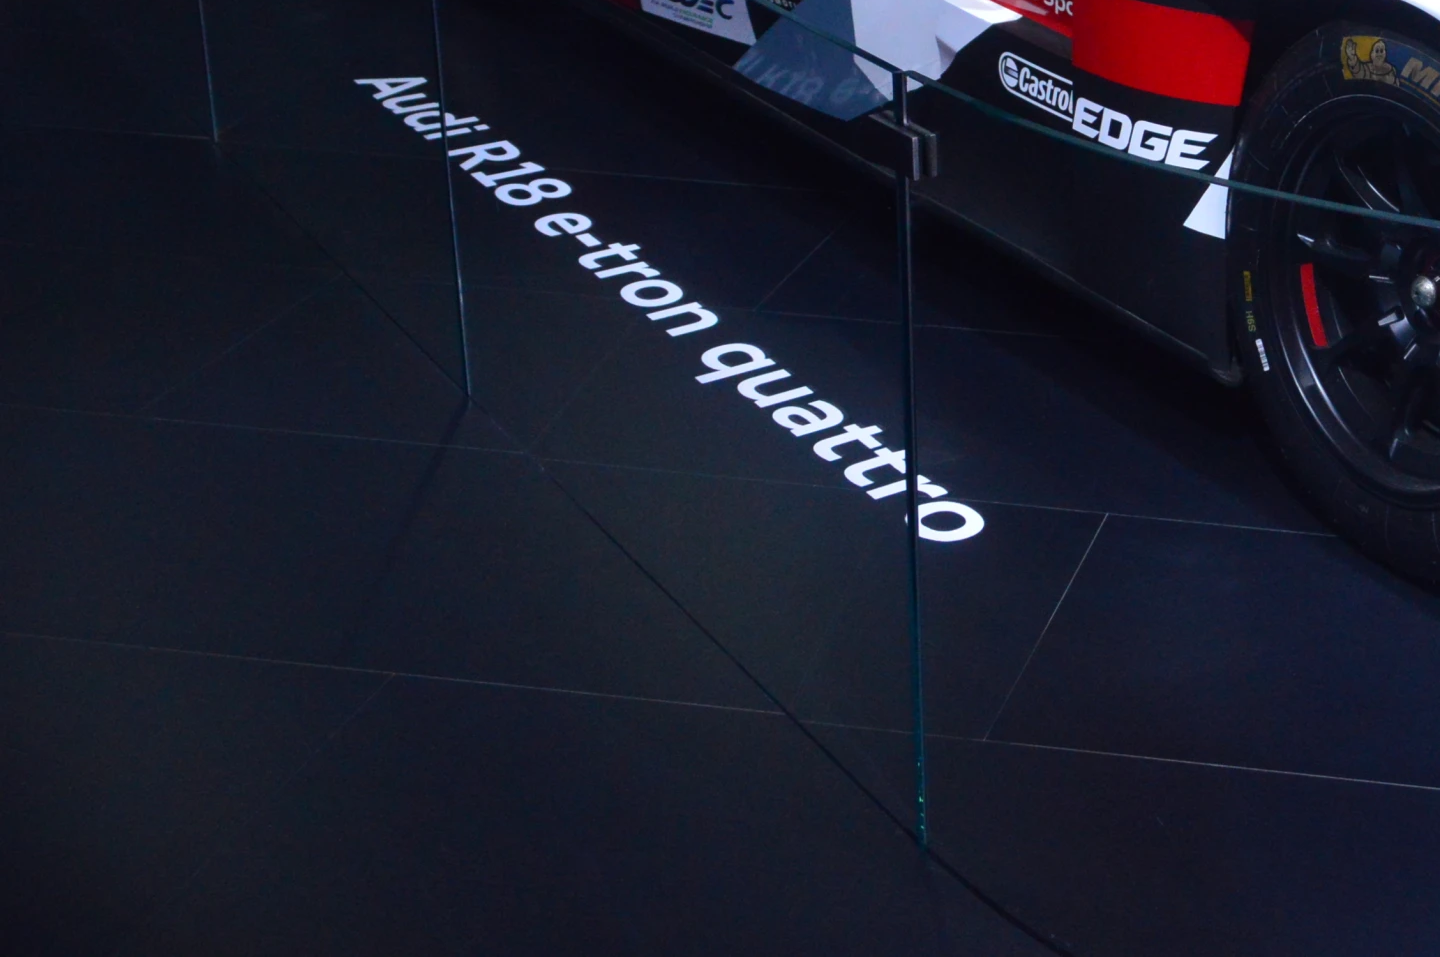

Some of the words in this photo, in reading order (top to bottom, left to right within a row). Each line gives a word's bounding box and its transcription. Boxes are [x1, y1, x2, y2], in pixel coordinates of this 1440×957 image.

[1018, 66, 1074, 115] Castrol
[1072, 96, 1219, 171] EDGE
[355, 76, 490, 141] Audi
[447, 140, 572, 206] R18
[533, 211, 719, 338] e-tron
[694, 341, 985, 542] quattro
